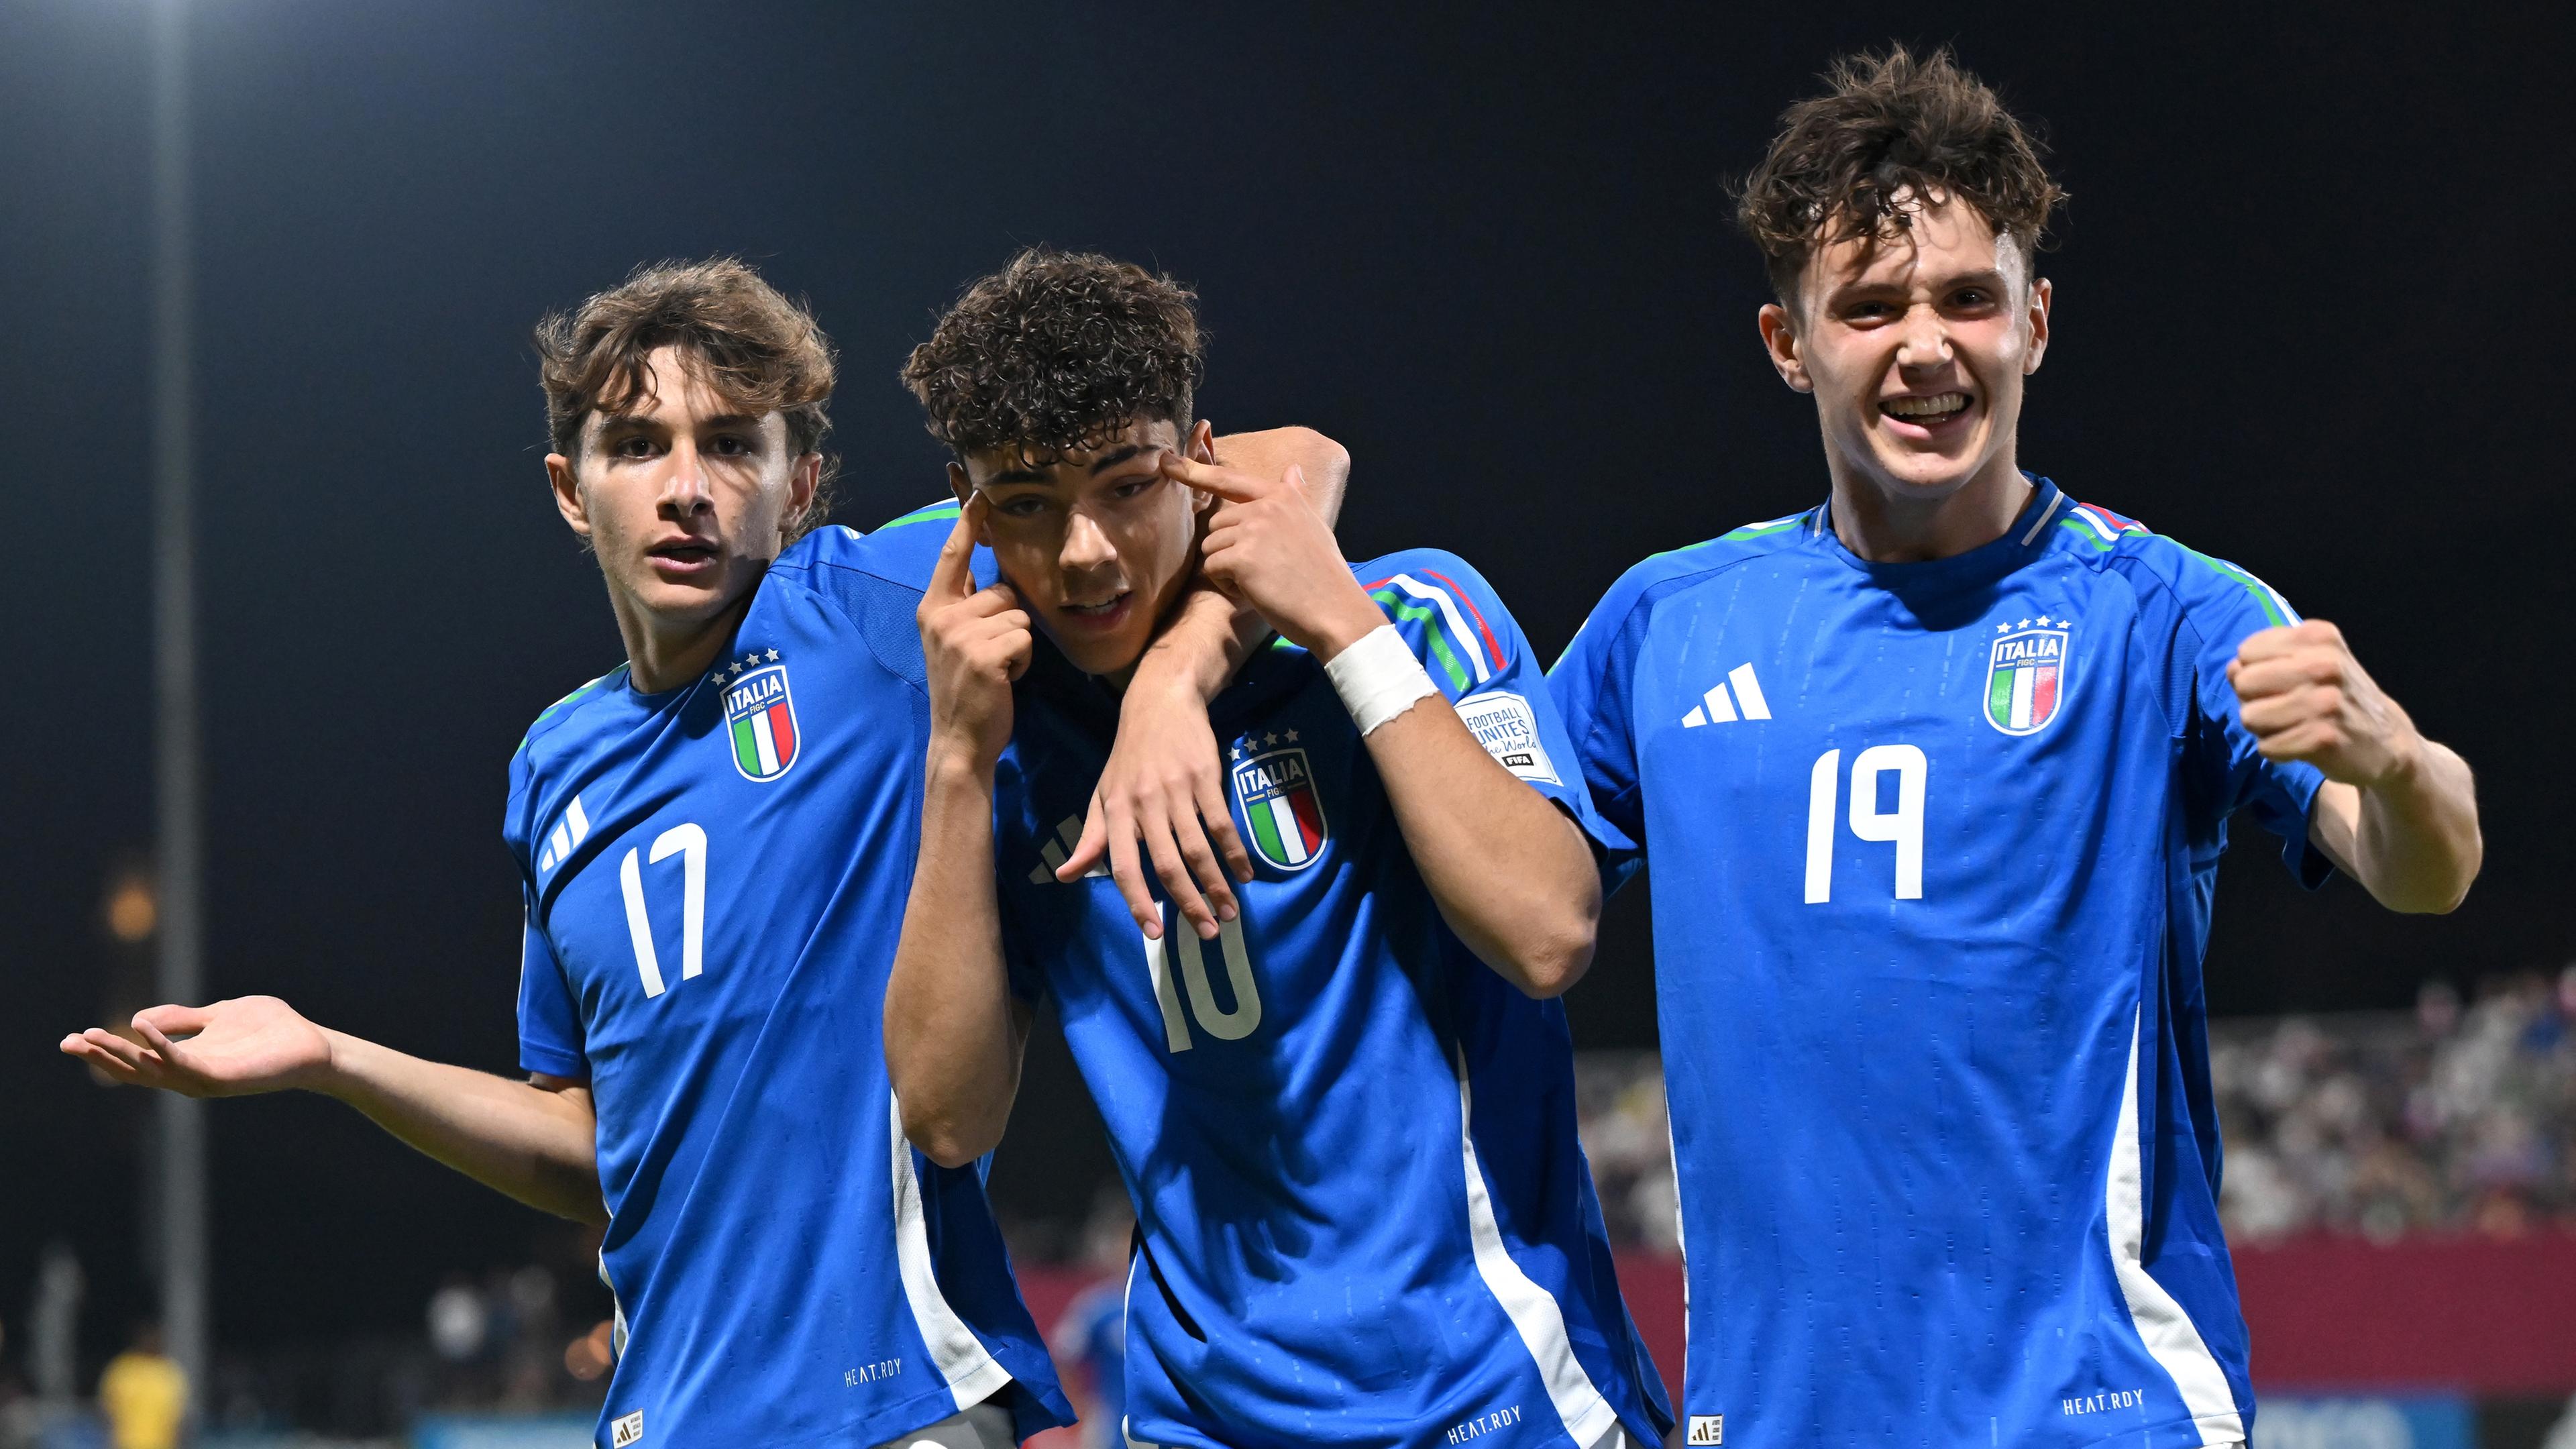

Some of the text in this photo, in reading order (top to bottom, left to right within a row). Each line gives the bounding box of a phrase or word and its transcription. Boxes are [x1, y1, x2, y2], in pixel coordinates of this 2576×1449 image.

[1996, 638, 2059, 661] ITALIA
[2017, 658, 2035, 667] FIGC
[727, 674, 783, 714] ITALIA
[749, 702, 765, 714] FIGC
[1466, 707, 1522, 731] FOOTBALL
[1505, 755, 1532, 765] FIFA
[1239, 758, 1304, 795] ITALIA
[1267, 786, 1285, 798] FIGC
[1805, 745, 1927, 904] 19
[620, 822, 708, 999] 17
[1142, 893, 1262, 1053] 10
[845, 1358, 900, 1388] HEAT.RDY
[2063, 1389, 2143, 1415] HEAT.RDY
[1447, 1405, 1521, 1446] HEAT.RDY
